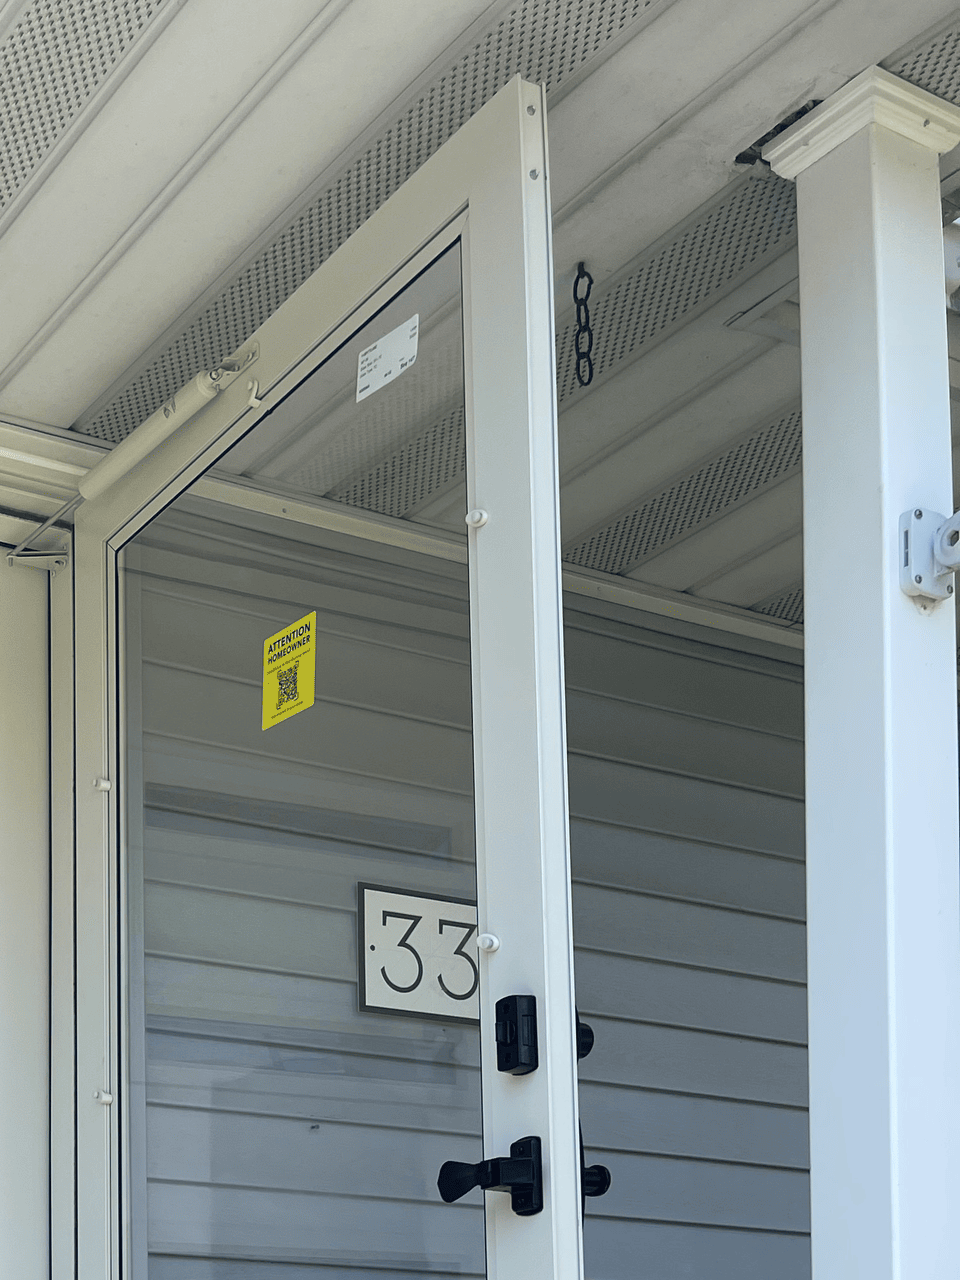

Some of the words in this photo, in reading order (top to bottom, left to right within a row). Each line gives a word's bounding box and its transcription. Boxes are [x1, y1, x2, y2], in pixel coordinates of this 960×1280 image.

[267, 621, 311, 655] ATTENTION
[267, 634, 311, 666] HOMEOWNER
[380, 910, 478, 1001] 33
